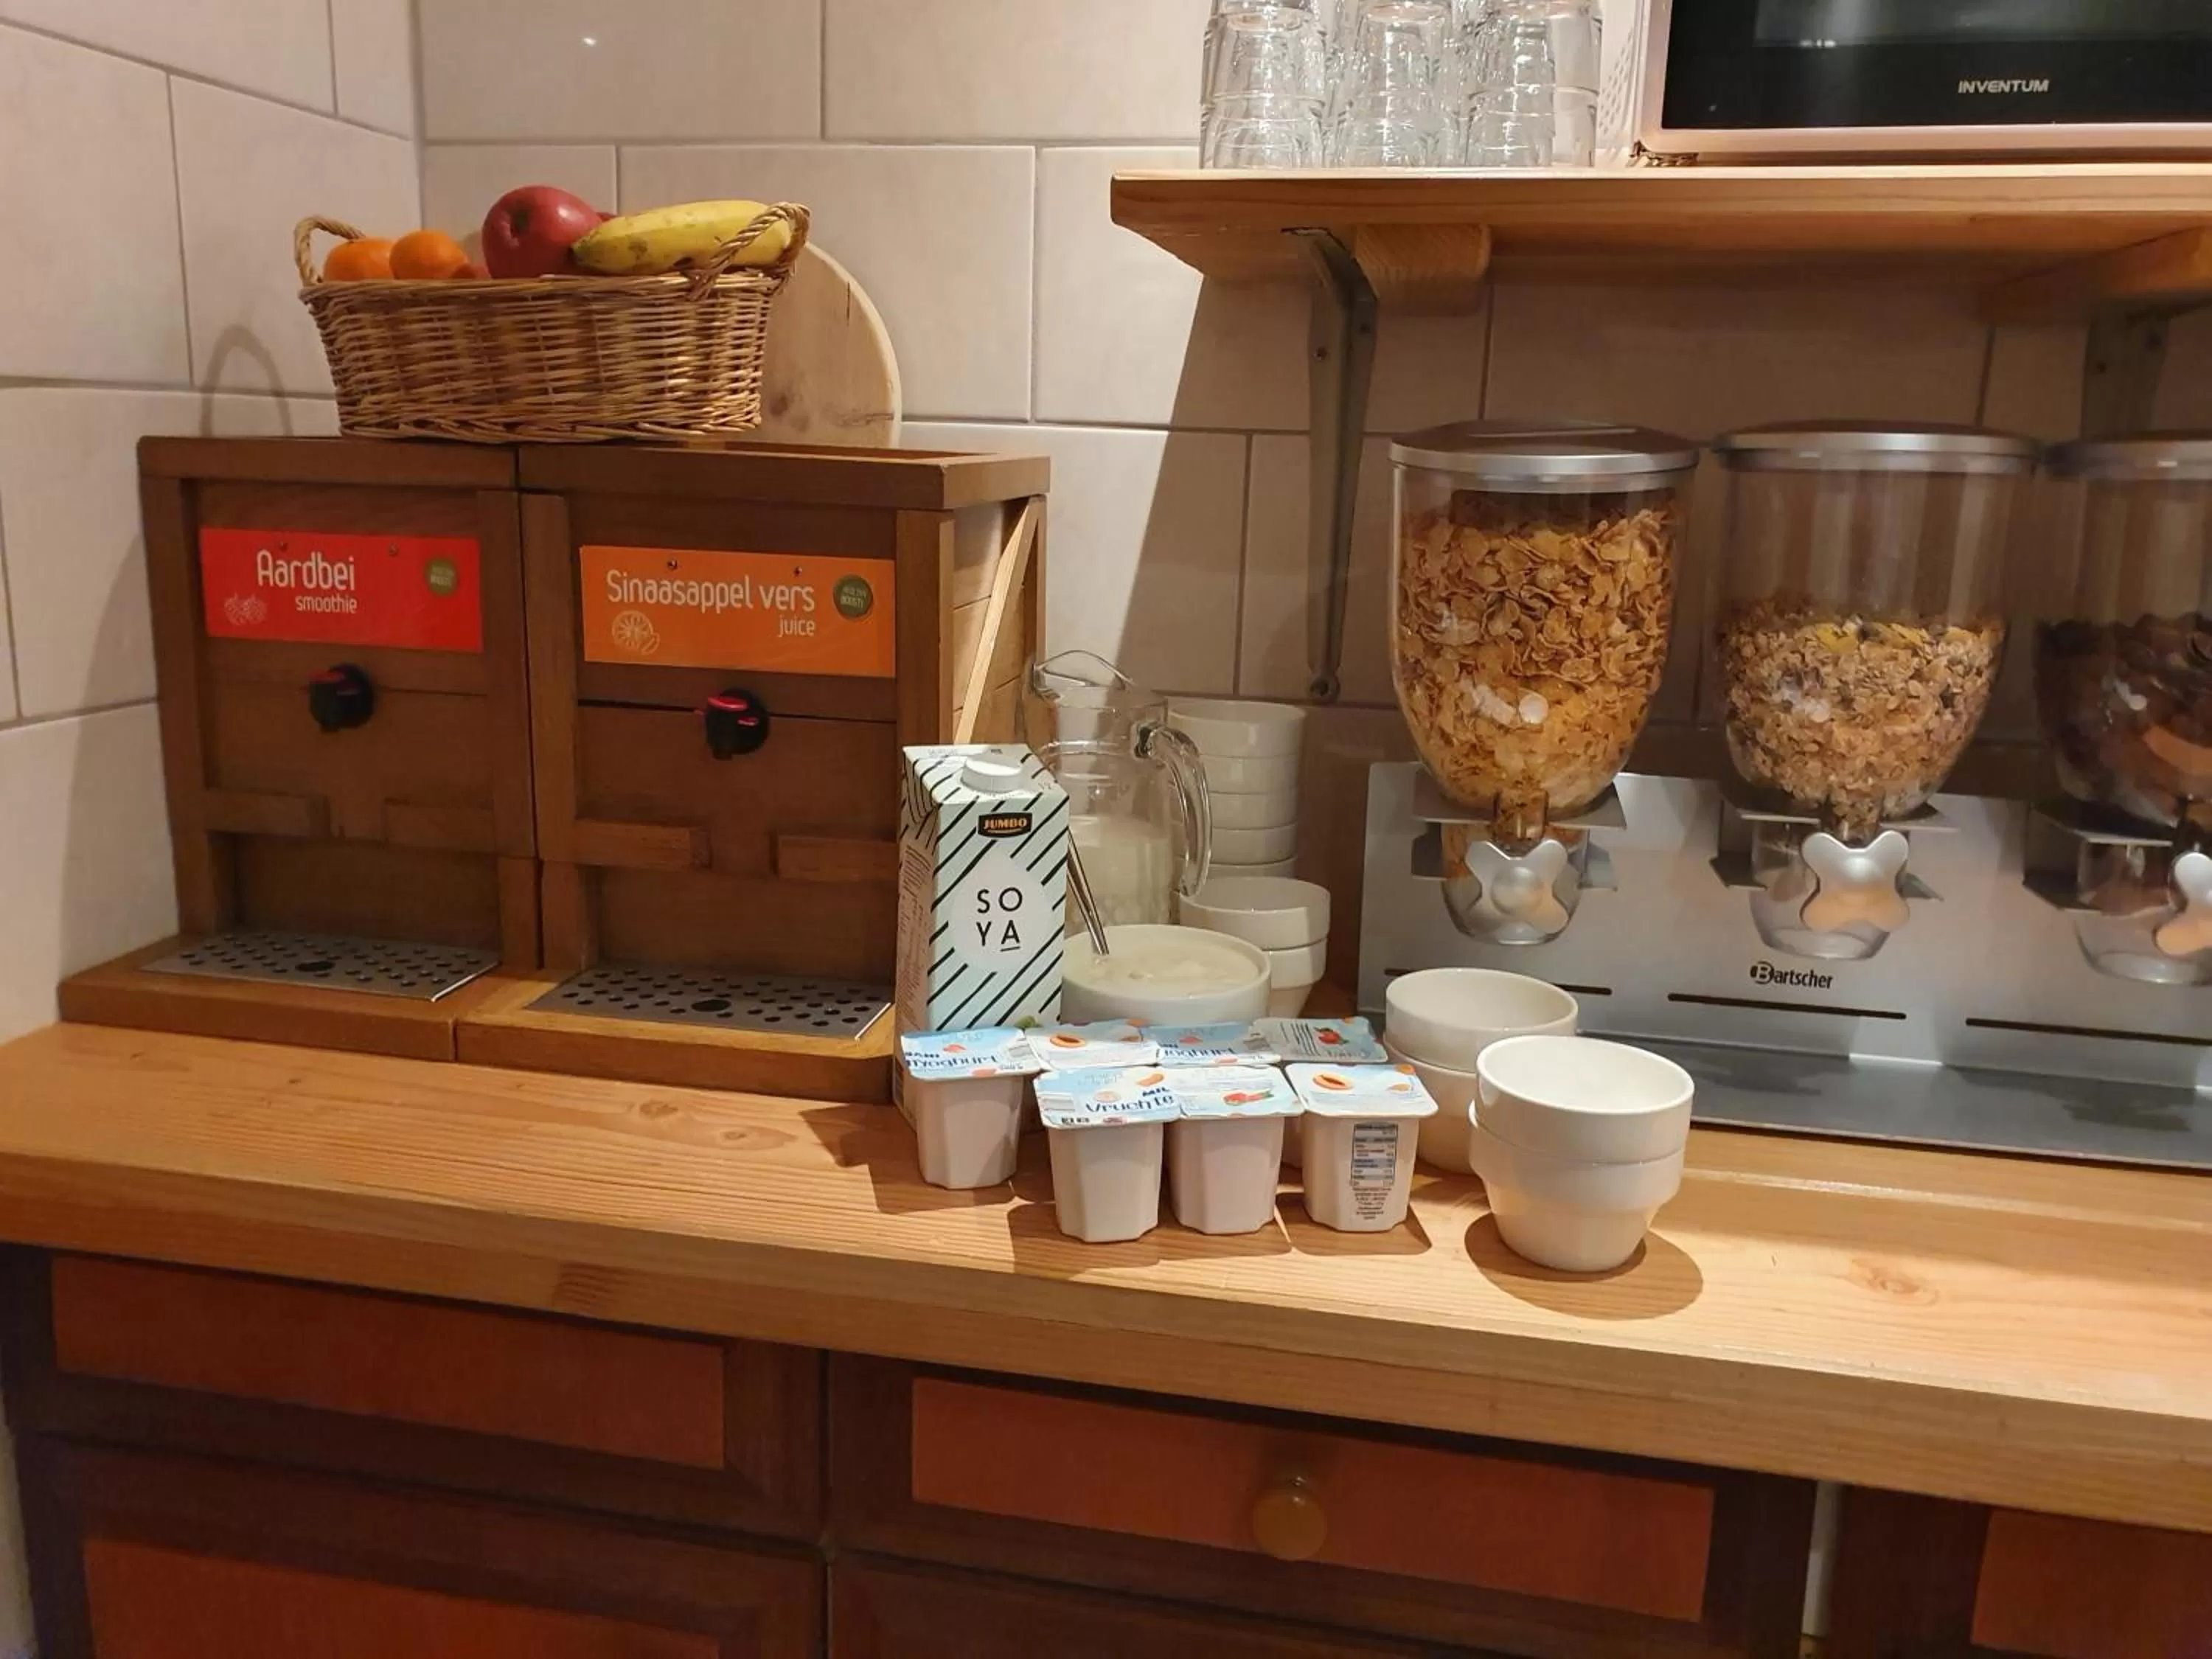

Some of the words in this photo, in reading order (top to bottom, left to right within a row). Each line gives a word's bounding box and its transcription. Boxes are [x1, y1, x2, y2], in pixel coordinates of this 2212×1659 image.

[1958, 79, 2050, 94] INVENTUM
[257, 549, 355, 591] Aardbei
[606, 568, 753, 614] Sinaasappel
[759, 583, 815, 613] vers
[295, 594, 358, 614] smoothie
[777, 613, 815, 638] juice
[983, 816, 1028, 830] JUMBO
[1750, 960, 1834, 990] Bartscher
[1085, 1095, 1175, 1113] Vruchte
